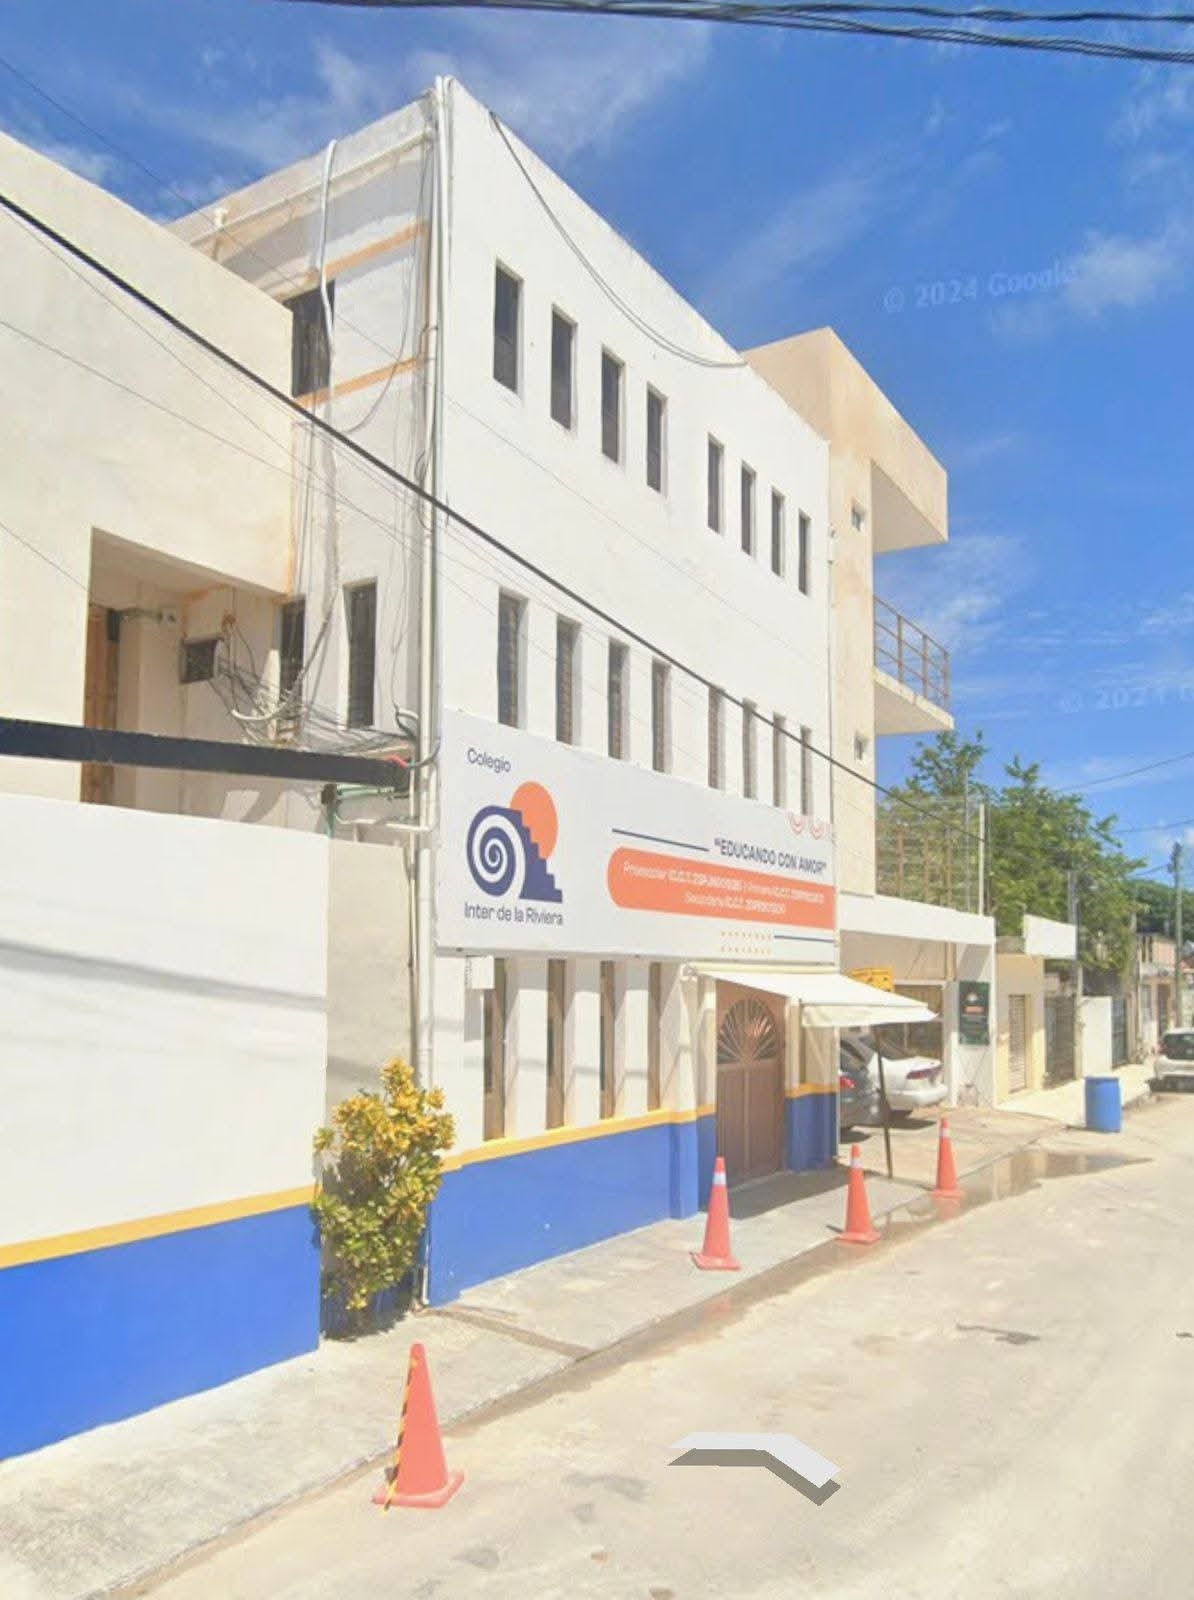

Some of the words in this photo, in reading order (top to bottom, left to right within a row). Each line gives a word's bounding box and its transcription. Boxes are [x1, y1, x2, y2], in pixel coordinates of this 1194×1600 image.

[467, 747, 512, 773] Colegio
[778, 852, 797, 870] CON
[464, 902, 496, 920] Inter
[497, 905, 512, 922] de
[514, 905, 524, 923] la
[526, 906, 564, 926] Riviera
